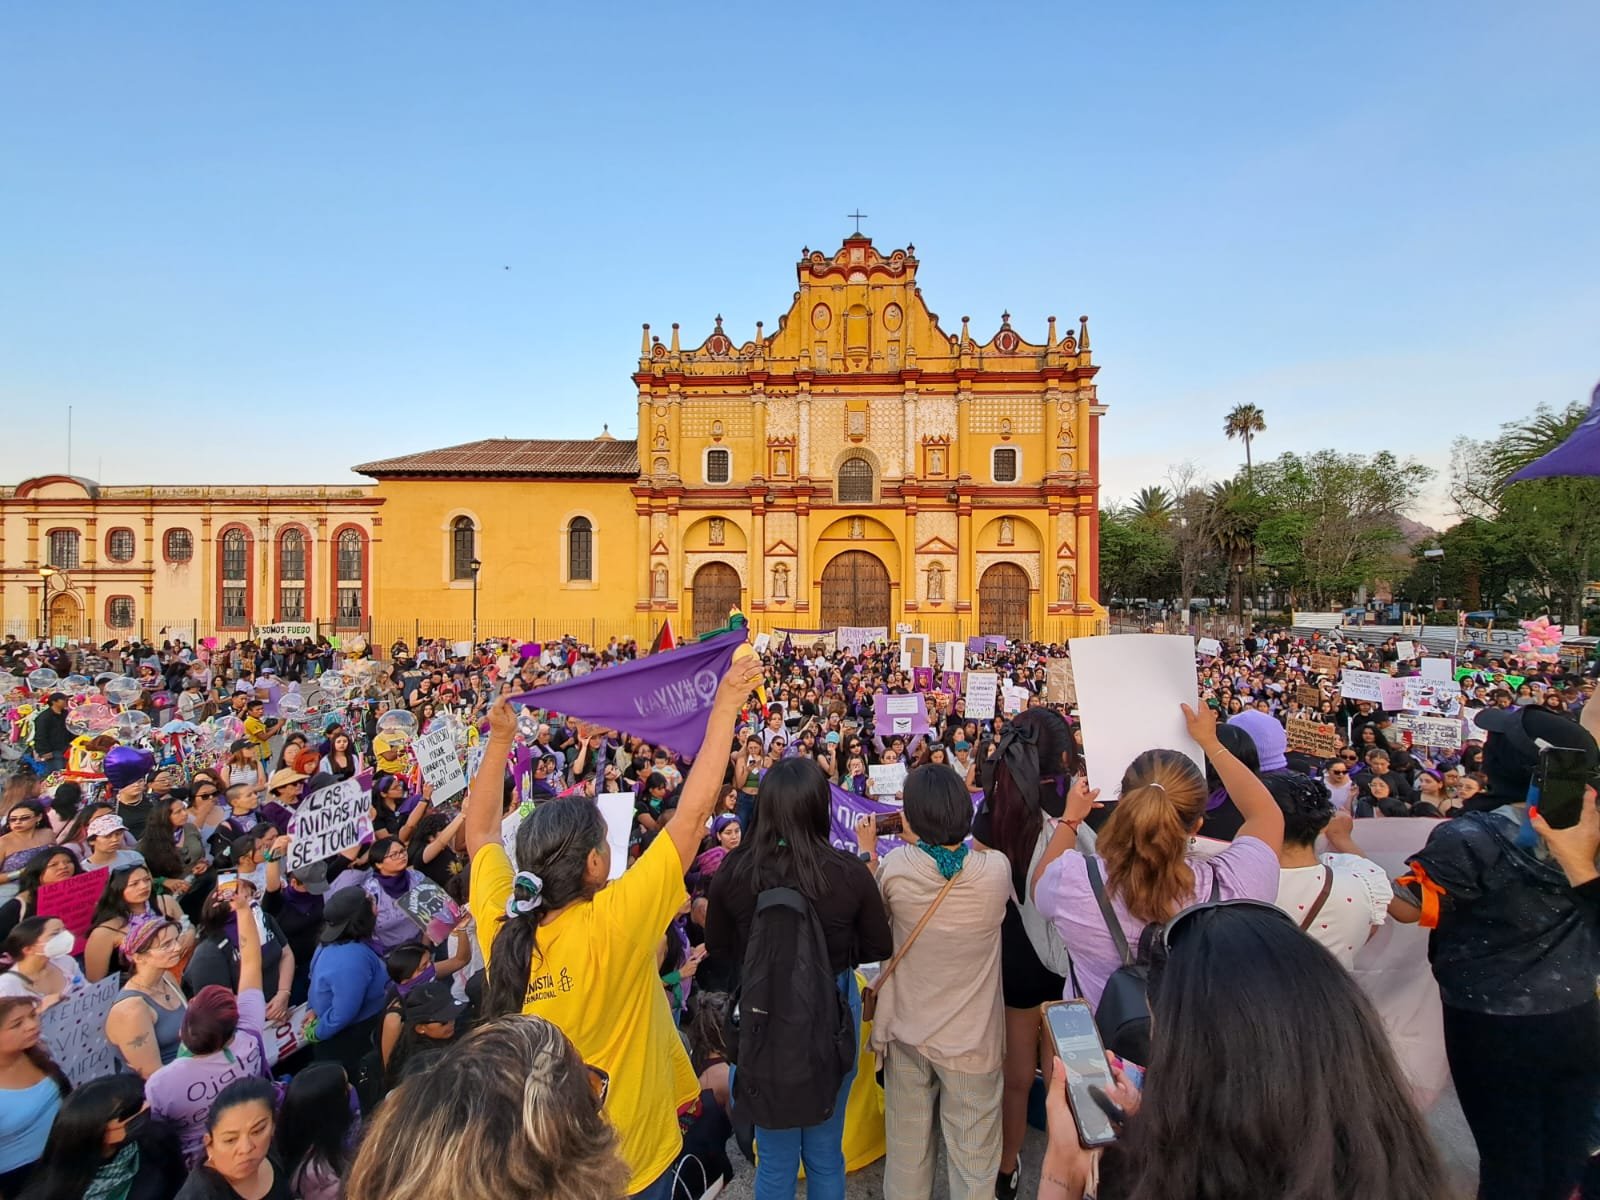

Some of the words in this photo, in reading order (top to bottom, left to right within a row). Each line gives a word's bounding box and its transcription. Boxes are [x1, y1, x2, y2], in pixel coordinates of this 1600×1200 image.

[261, 626, 285, 634] SOMOS
[287, 626, 311, 634] FUEGO
[310, 786, 342, 811] LAS
[300, 802, 350, 838] NIÑAS
[353, 796, 370, 818] NO
[292, 842, 313, 869] SE
[317, 821, 359, 856] TOCAN
[524, 990, 557, 1005] ERNACIONAL
[528, 972, 554, 994] NISTÍA
[49, 982, 116, 1025] RECEMOS
[56, 1023, 90, 1052] VIR
[187, 1041, 259, 1102] Ojalá
